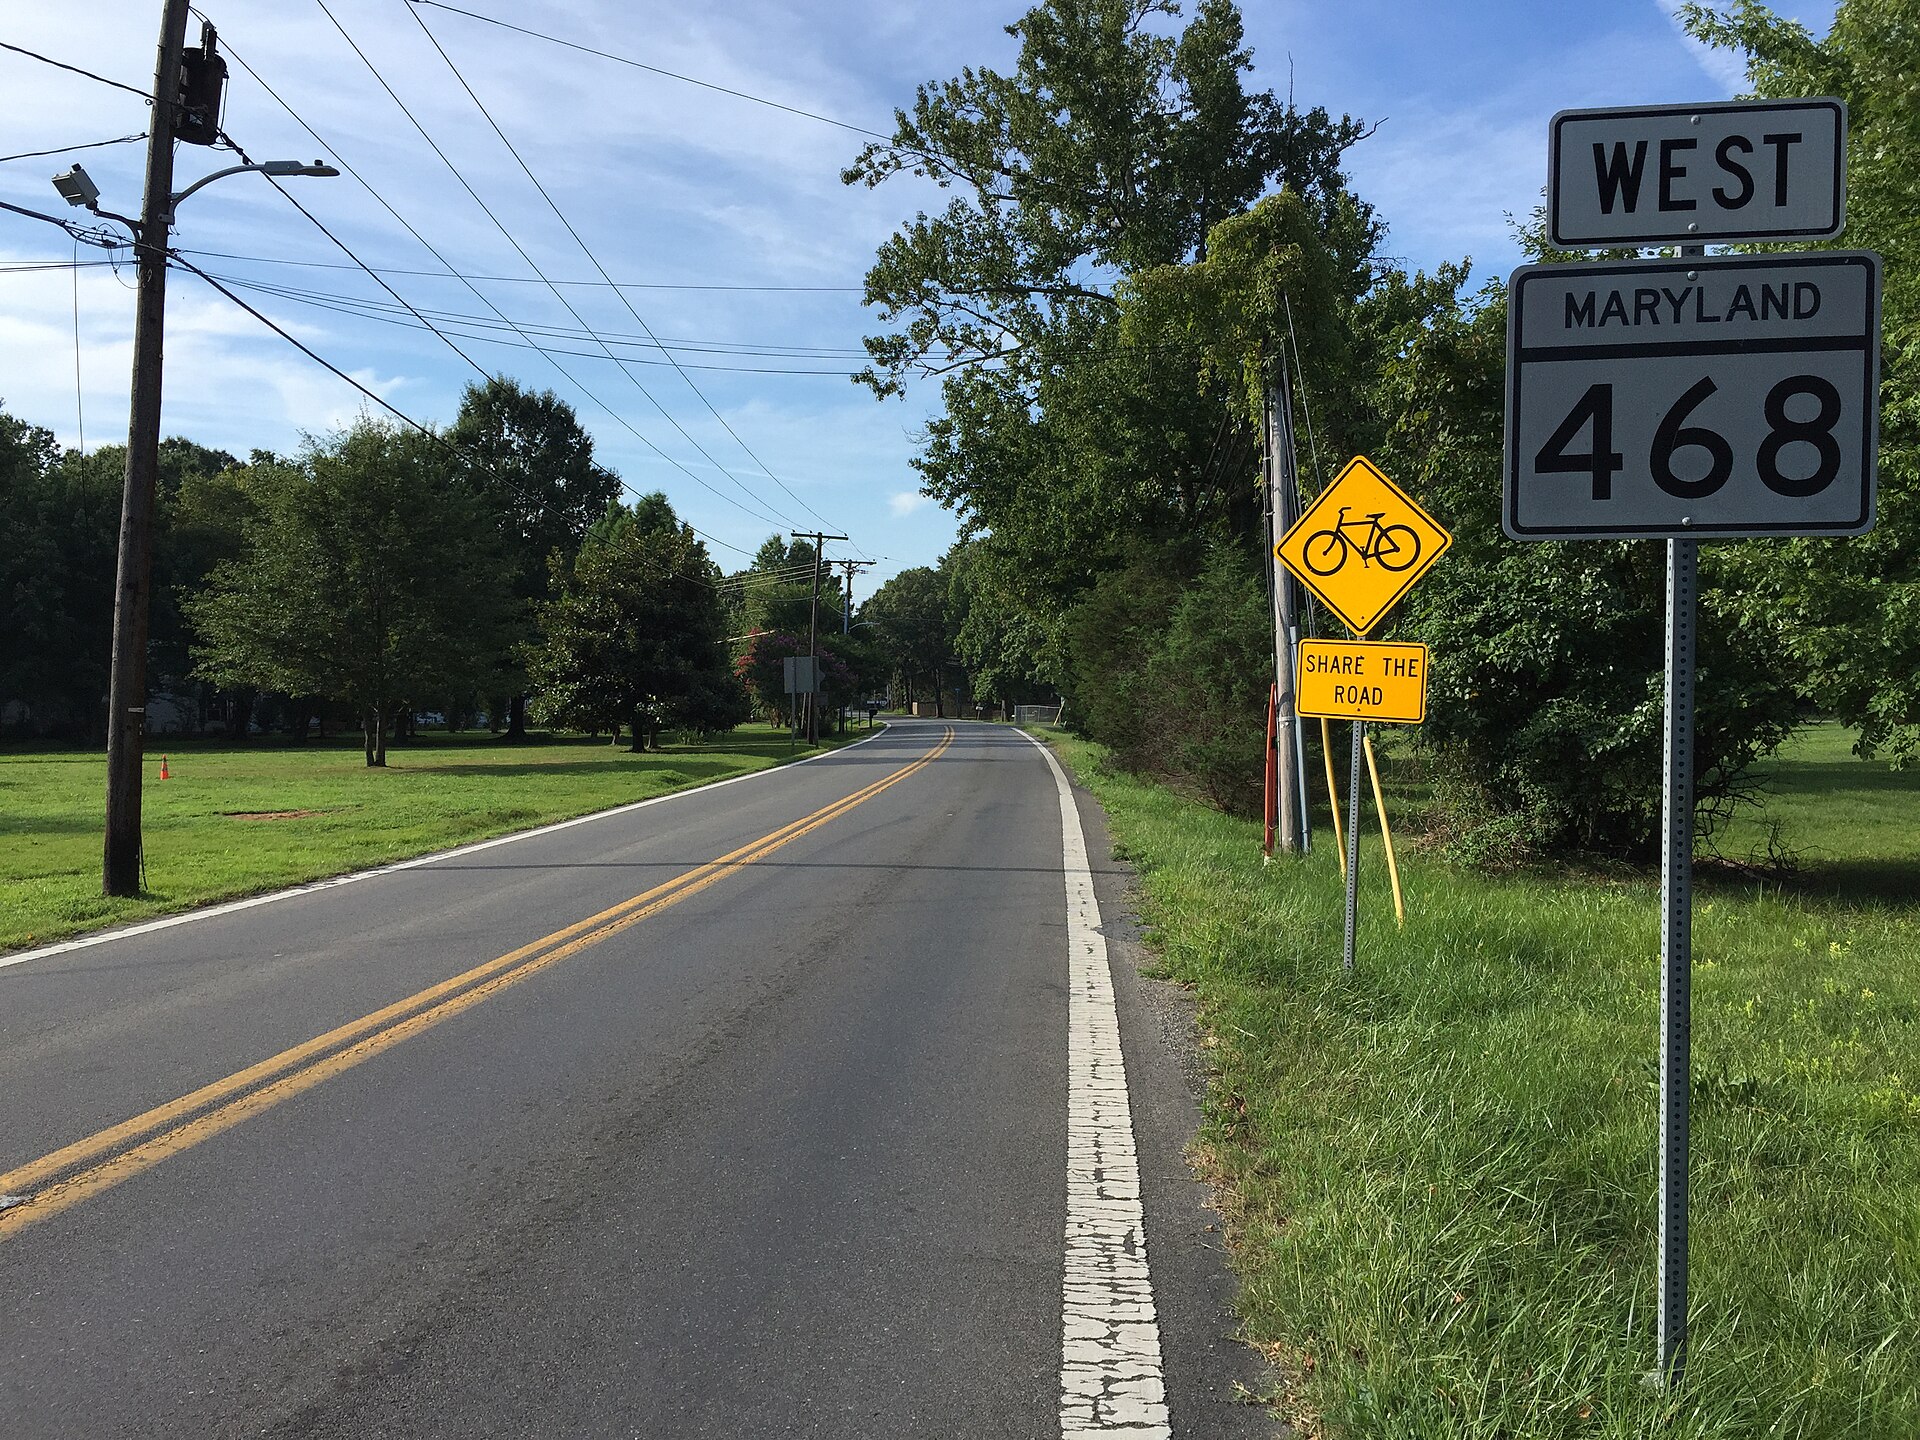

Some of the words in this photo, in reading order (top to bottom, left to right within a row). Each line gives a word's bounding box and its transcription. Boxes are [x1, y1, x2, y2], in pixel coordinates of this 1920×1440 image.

[1592, 133, 1803, 214] WEST
[1564, 281, 1822, 329] MARYLAND
[1534, 374, 1842, 501] 468
[1306, 654, 1365, 675] SHARE
[1383, 657, 1419, 677] THE
[1334, 685, 1383, 706] ROAD
